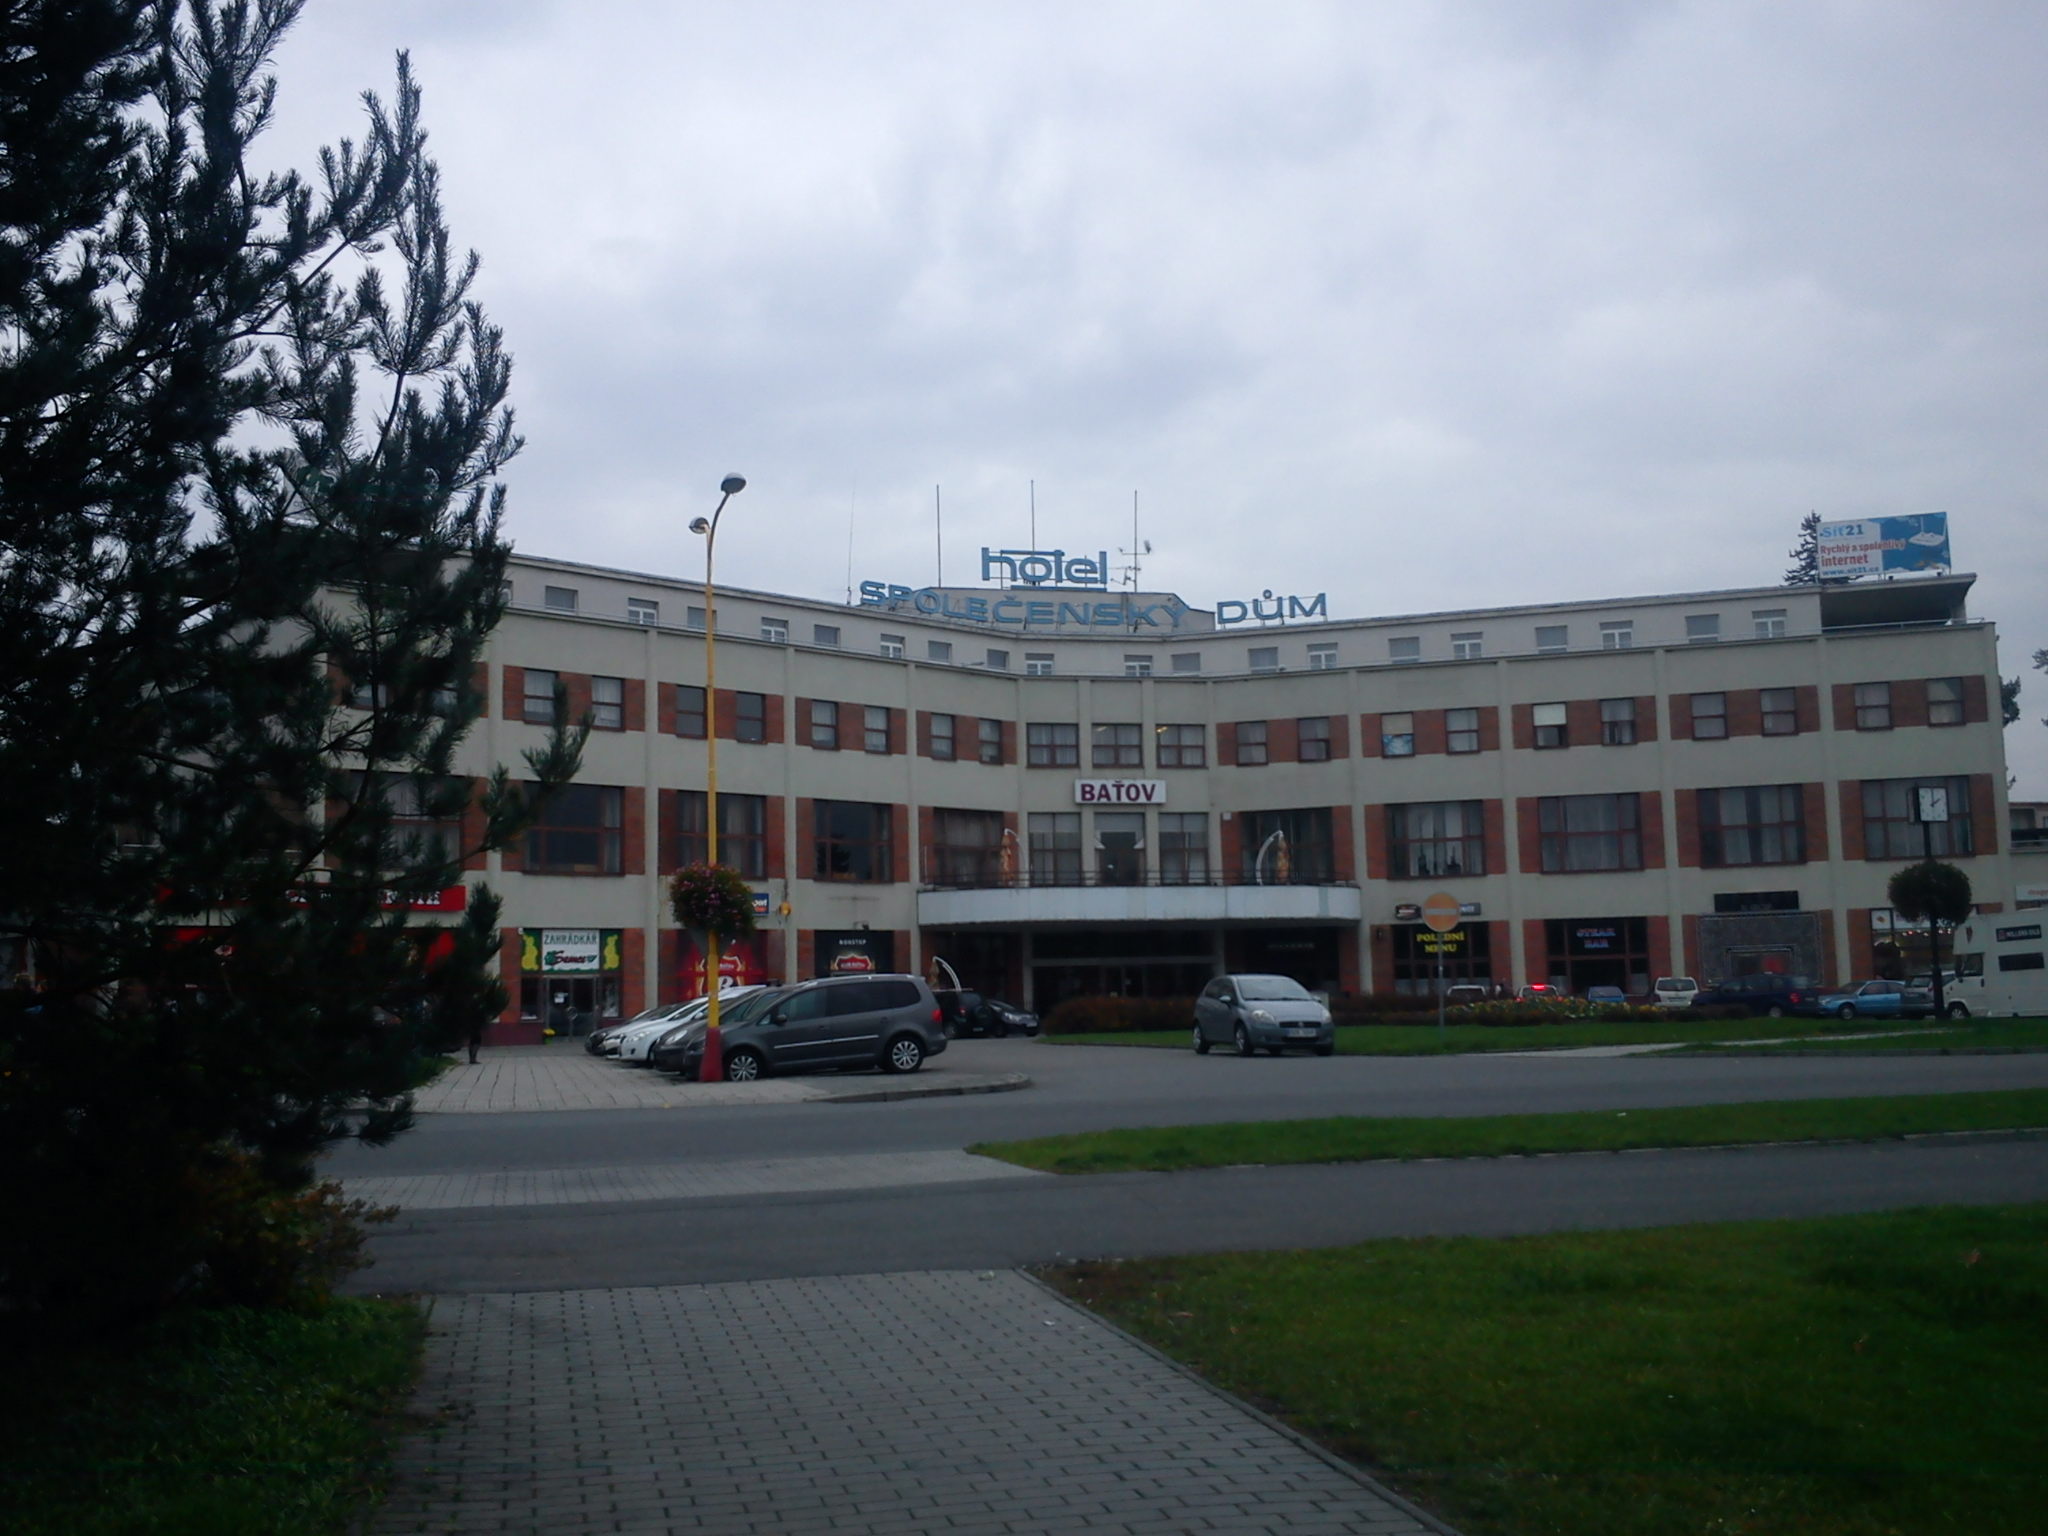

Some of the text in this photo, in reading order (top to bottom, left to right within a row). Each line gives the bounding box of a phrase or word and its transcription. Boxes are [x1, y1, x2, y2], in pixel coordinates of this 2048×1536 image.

[981, 546, 1107, 583] hotel
[1821, 554, 1869, 567] internet
[1217, 589, 1327, 624] DŮM
[1080, 780, 1156, 802] BAŤOV
